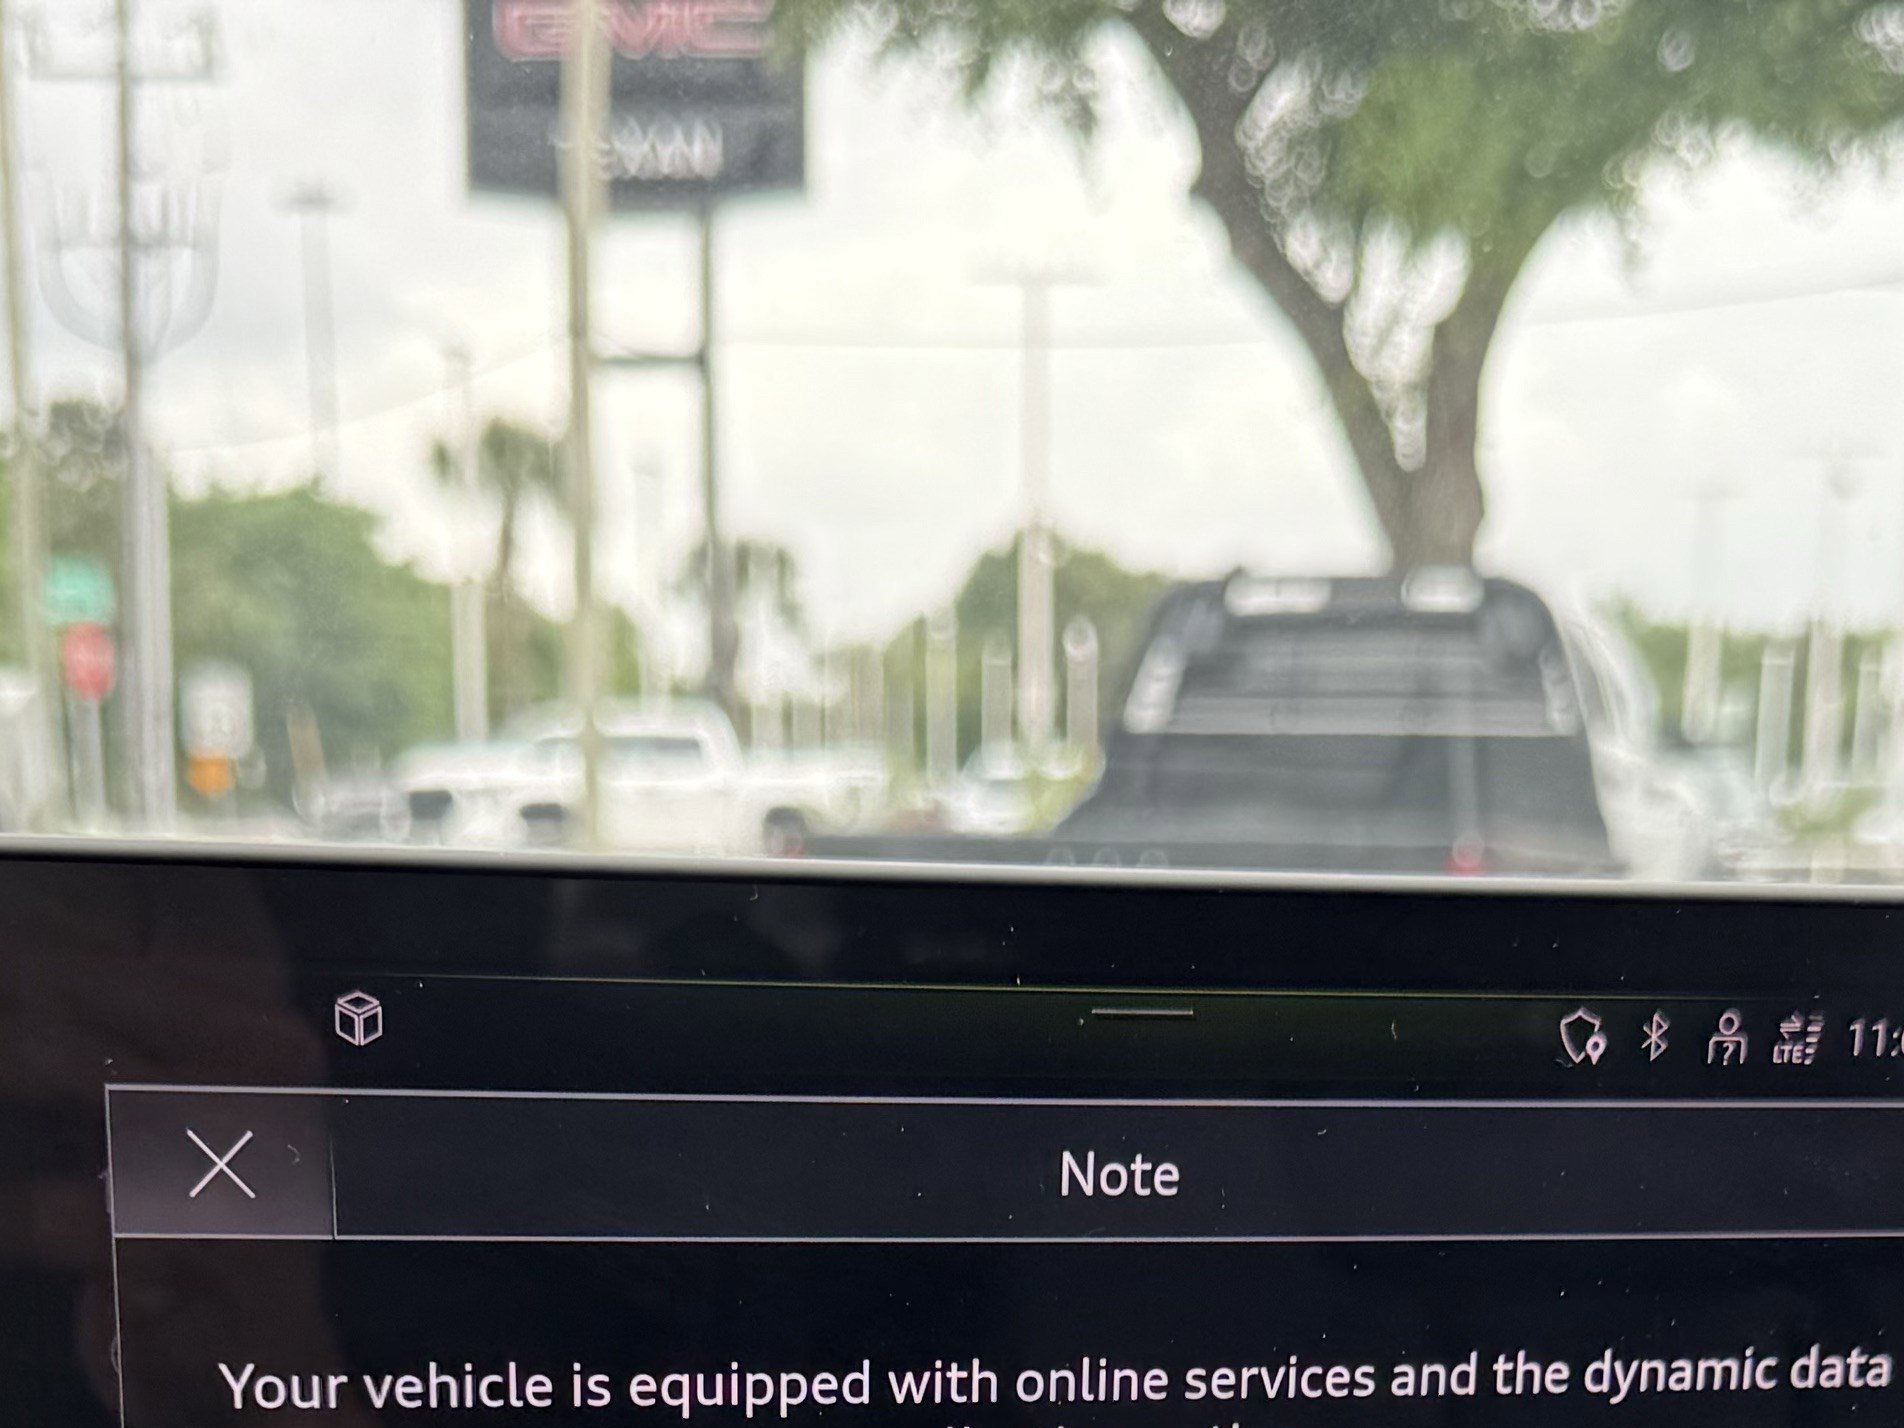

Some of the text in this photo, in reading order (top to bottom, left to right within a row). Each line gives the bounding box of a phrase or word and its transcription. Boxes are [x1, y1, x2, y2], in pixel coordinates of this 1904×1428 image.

[1061, 1150, 1180, 1197] Note
[217, 1343, 1892, 1420] Your vehicle is equipped with online services and the dynamic data
